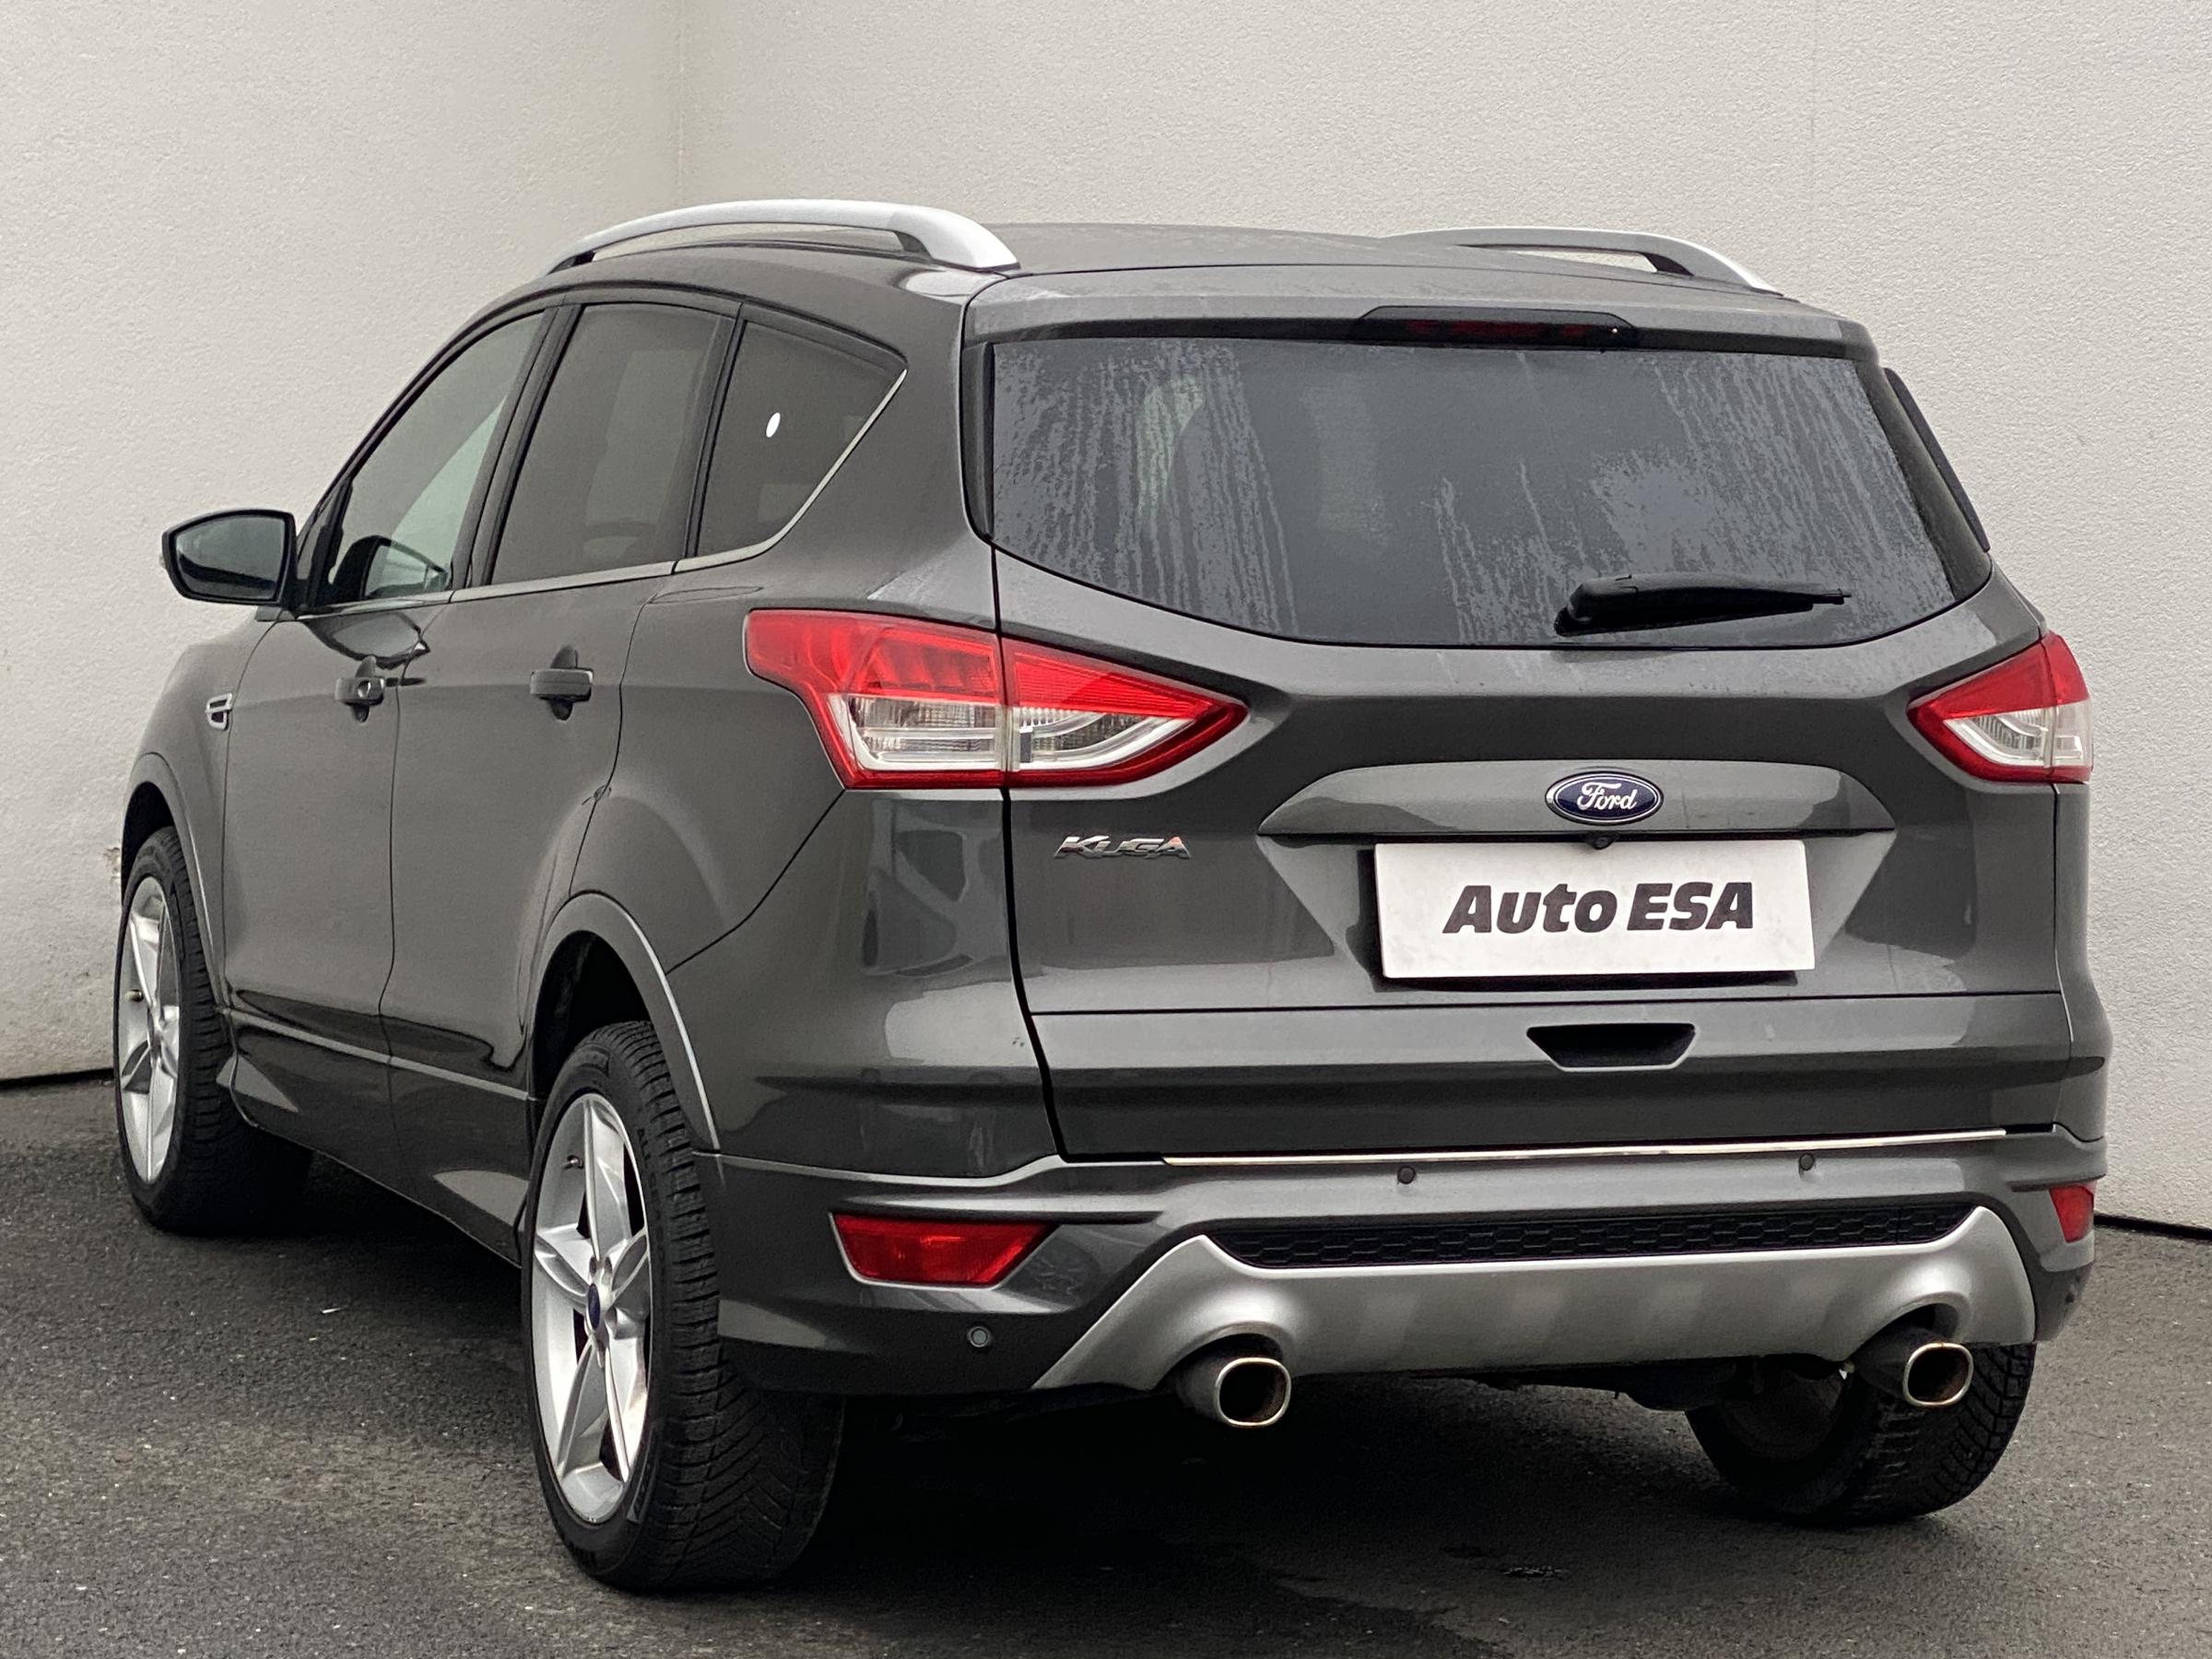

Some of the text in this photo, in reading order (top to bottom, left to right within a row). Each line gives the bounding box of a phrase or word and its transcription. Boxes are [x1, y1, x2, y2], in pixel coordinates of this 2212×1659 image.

[1577, 782, 1638, 810] Ford
[1053, 835, 1192, 859] KUGA
[1442, 881, 1753, 934] Auto ESA
